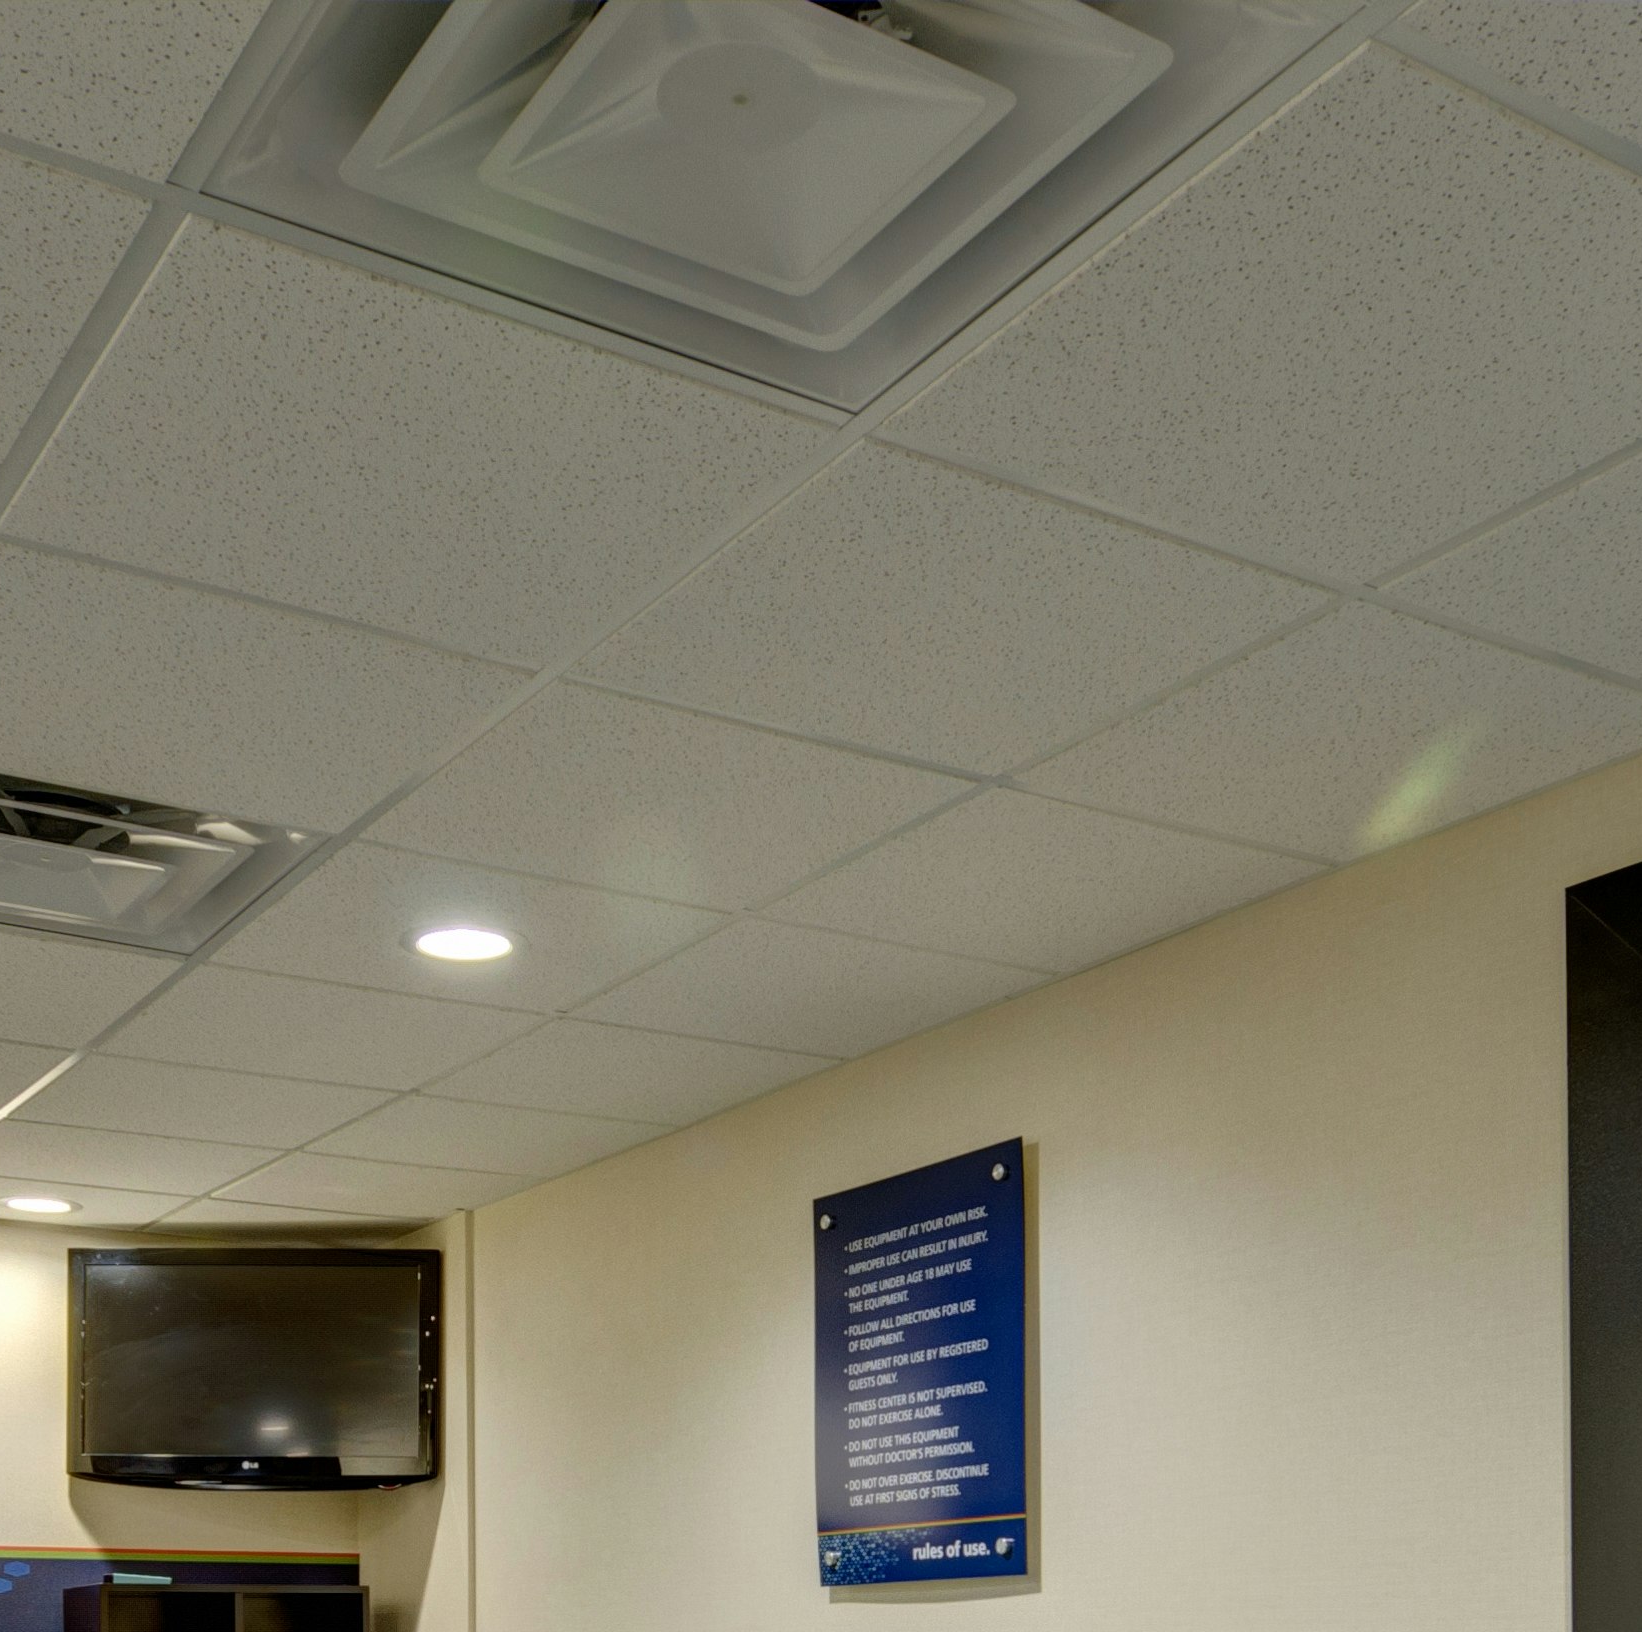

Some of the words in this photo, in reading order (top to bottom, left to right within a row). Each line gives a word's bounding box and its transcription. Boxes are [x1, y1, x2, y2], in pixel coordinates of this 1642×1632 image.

[849, 1241, 863, 1252] USE
[864, 1227, 907, 1248] EQUIPMENT
[909, 1224, 919, 1236] AT
[921, 1218, 943, 1232] YOUR
[945, 1211, 966, 1226] OWN
[968, 1206, 988, 1221] RISK.
[849, 1256, 885, 1275] IMPROPER
[887, 1252, 900, 1266] USE
[901, 1248, 918, 1262] CAN
[919, 1239, 947, 1257] RESULT
[948, 1238, 957, 1250] IN
[958, 1230, 989, 1248] INJURY.
[849, 1286, 861, 1298] NO
[862, 1282, 877, 1295] ONE
[879, 1275, 905, 1291] UNDER
[906, 1270, 923, 1284] AGE
[925, 1268, 934, 1280] 18
[936, 1262, 955, 1277] MAY
[957, 1258, 972, 1272] USE
[849, 1301, 863, 1314] THE
[864, 1290, 909, 1311] EQUIPMENT.
[849, 1320, 879, 1336] FOLLOW
[881, 1317, 894, 1329] ALL
[896, 1307, 941, 1326] DIRECTIONS
[942, 1303, 959, 1316] FOR
[960, 1299, 976, 1312] USE
[849, 1341, 859, 1352] OF
[860, 1331, 905, 1350] EQUIPMENT.
[849, 1357, 892, 1375] EQUIPMENT
[893, 1354, 909, 1366] FOR
[910, 1350, 925, 1364] USE
[927, 1348, 938, 1360] BY
[939, 1338, 989, 1358] REGISTERED
[849, 1376, 875, 1391] GUESTS
[877, 1372, 898, 1386] ONLY.
[849, 1399, 876, 1413] FITNESS
[878, 1394, 906, 1409] CENTER
[908, 1392, 915, 1403] IS
[917, 1389, 934, 1402] NOT
[936, 1381, 988, 1400] SUPERVISED.
[849, 1418, 860, 1429] DO
[862, 1415, 877, 1426] NOT
[879, 1409, 913, 1425] EXERCISE
[914, 1404, 943, 1419] ALONE.
[849, 1441, 860, 1452] DO
[862, 1438, 877, 1451] NOT
[879, 1436, 893, 1448] USE
[895, 1433, 911, 1445] THIS
[913, 1426, 959, 1444] EQUIPMENT
[849, 1454, 883, 1468] WITHOUT
[885, 1448, 923, 1464] DOCTOR'S
[925, 1441, 975, 1458] PERMISSION.
[849, 1480, 861, 1491] DO
[862, 1478, 877, 1489] NOT
[879, 1475, 898, 1486] OVER
[900, 1470, 934, 1485] EXERCISE.
[936, 1463, 989, 1480] DISCONTINUE
[850, 1496, 863, 1506] USE
[865, 1494, 875, 1504] AT
[876, 1491, 894, 1503] FIRST
[896, 1488, 917, 1501] SIGNS
[919, 1487, 930, 1499] OF
[932, 1484, 961, 1498] STRESS.
[912, 1542, 943, 1560] rules
[946, 1540, 961, 1558] of
[963, 1542, 990, 1556] use.
